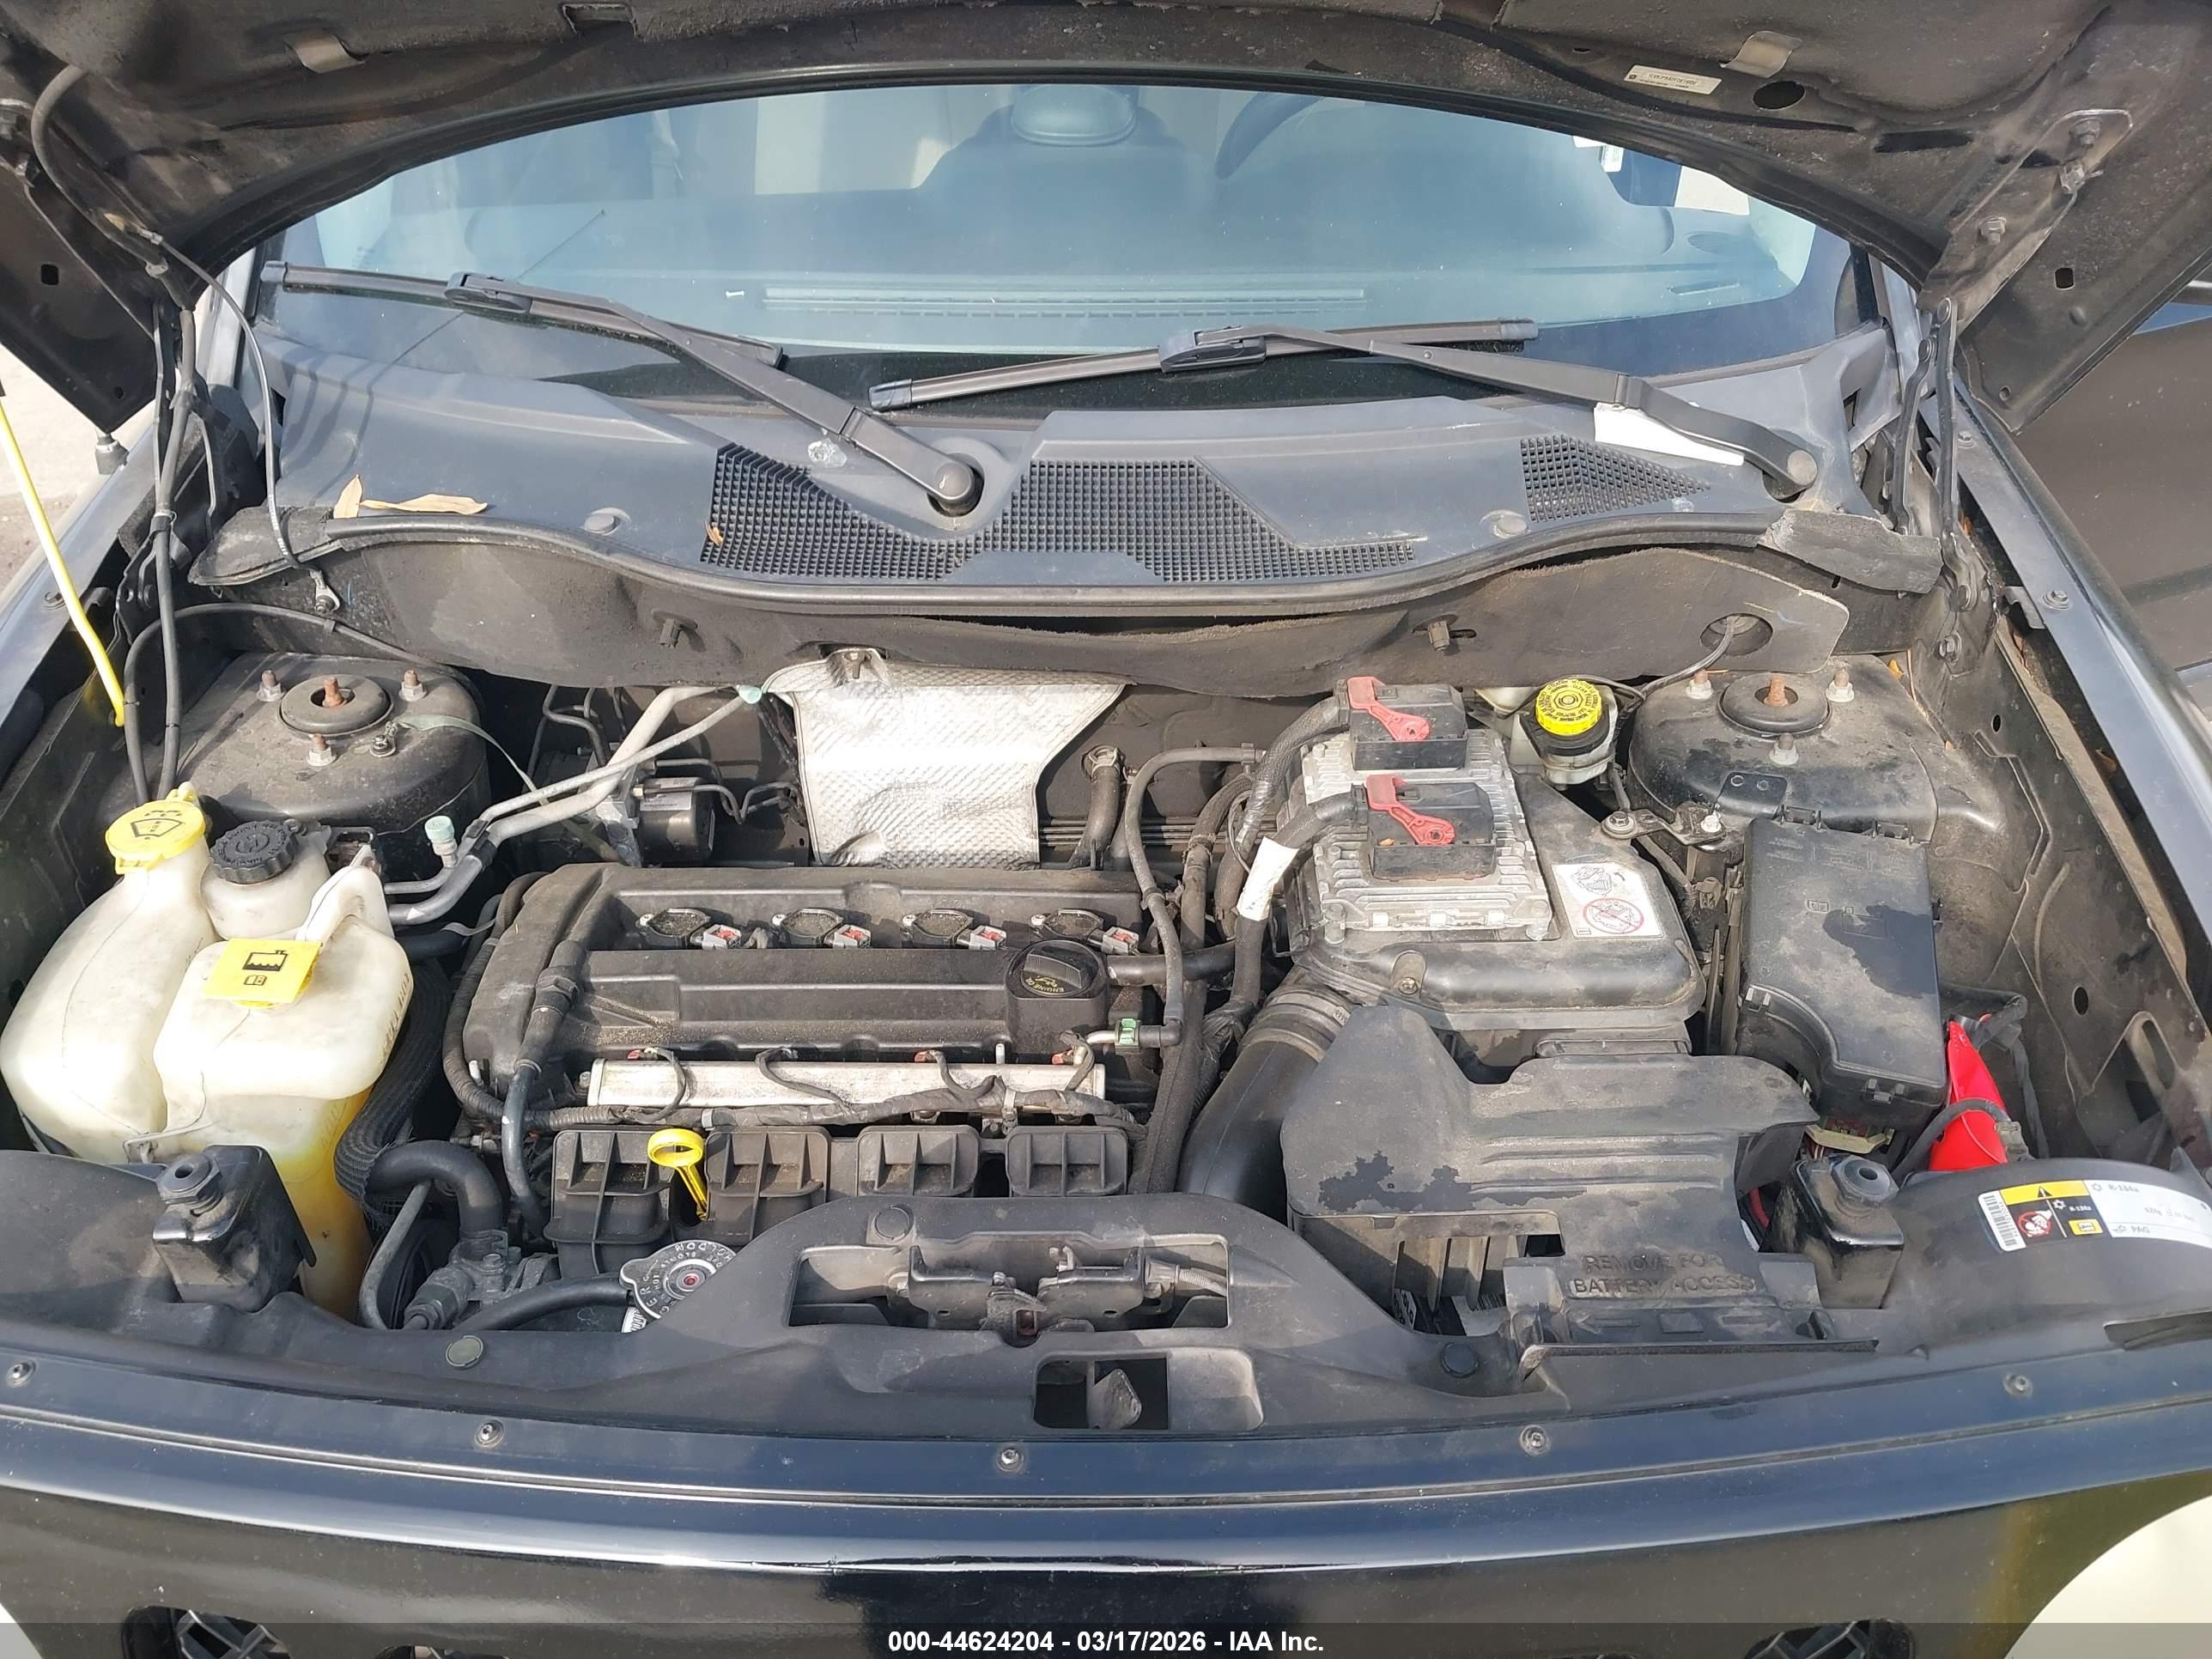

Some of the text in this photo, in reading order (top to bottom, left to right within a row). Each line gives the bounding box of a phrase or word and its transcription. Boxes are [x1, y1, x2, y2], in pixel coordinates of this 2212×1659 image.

[1583, 1251, 1724, 1272] REMOVE FOR
[1573, 1275, 1755, 1293] BATTERY ACCESS
